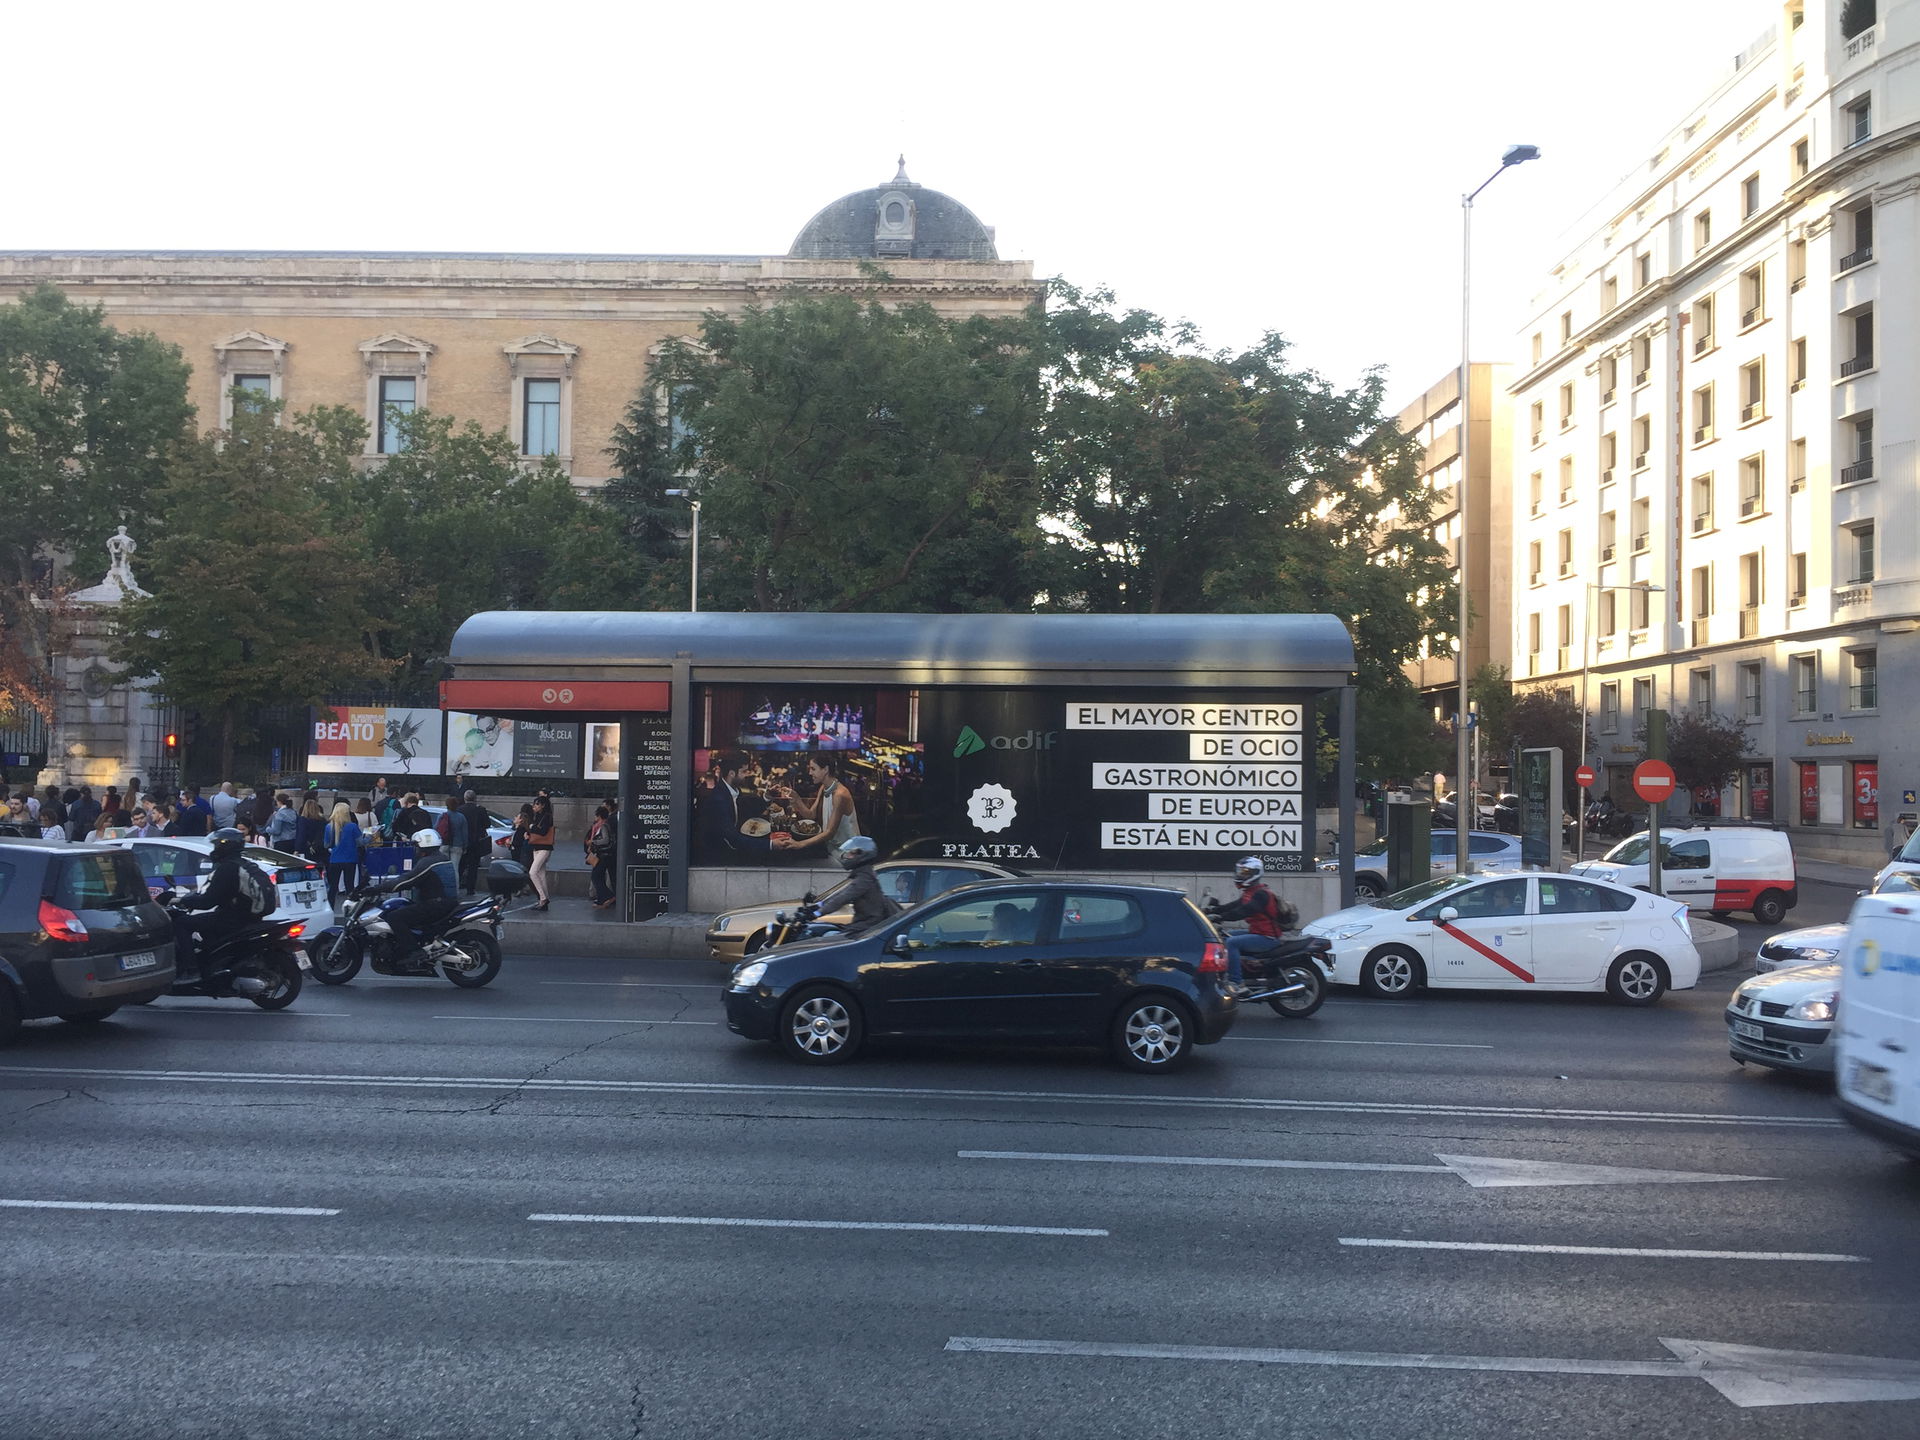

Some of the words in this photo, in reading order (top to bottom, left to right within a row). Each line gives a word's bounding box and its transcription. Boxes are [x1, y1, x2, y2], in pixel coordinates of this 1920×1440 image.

[520, 721, 544, 731] CAMILO
[1079, 708, 1105, 725] EL
[1112, 708, 1195, 725] MAYOR
[1202, 709, 1298, 726] CENTRO
[314, 722, 375, 741] BEATO
[539, 728, 555, 739] JOSÉ
[557, 730, 573, 740] CELA
[990, 730, 1058, 750] adif
[1204, 739, 1233, 756] DE
[1240, 739, 1298, 756] OCIO
[1104, 765, 1298, 787] GASTRONÓMICO
[981, 797, 1004, 818] P
[1162, 798, 1192, 815] DE
[1200, 798, 1298, 816] EUROPA
[1112, 824, 1171, 846] ESTÁ
[1178, 828, 1208, 846] EN
[1215, 825, 1297, 847] COLÓN
[942, 843, 1040, 859] PLATEA
[1287, 855, 1302, 863] 5-7
